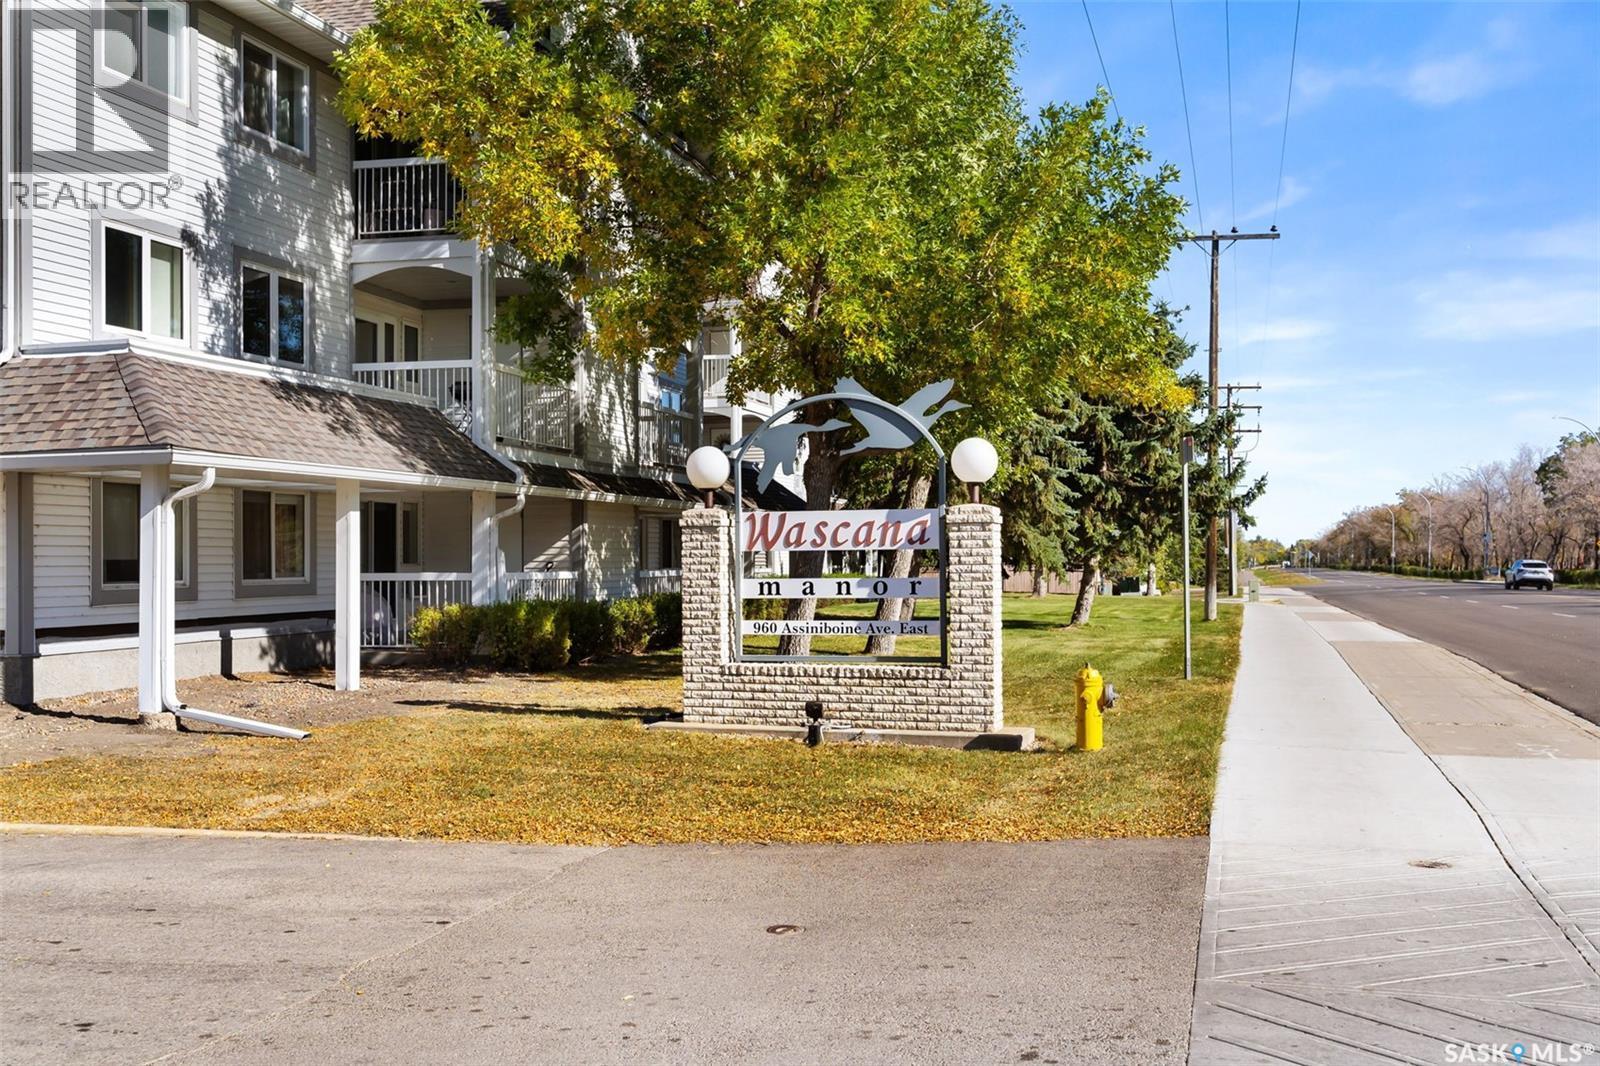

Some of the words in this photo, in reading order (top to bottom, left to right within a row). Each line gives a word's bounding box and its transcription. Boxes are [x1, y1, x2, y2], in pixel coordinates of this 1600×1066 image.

[744, 511, 931, 551] Wascana
[753, 621, 777, 635] 960
[782, 621, 861, 635] Assiniboine
[865, 622, 894, 635] Ave.
[899, 622, 929, 635] East
